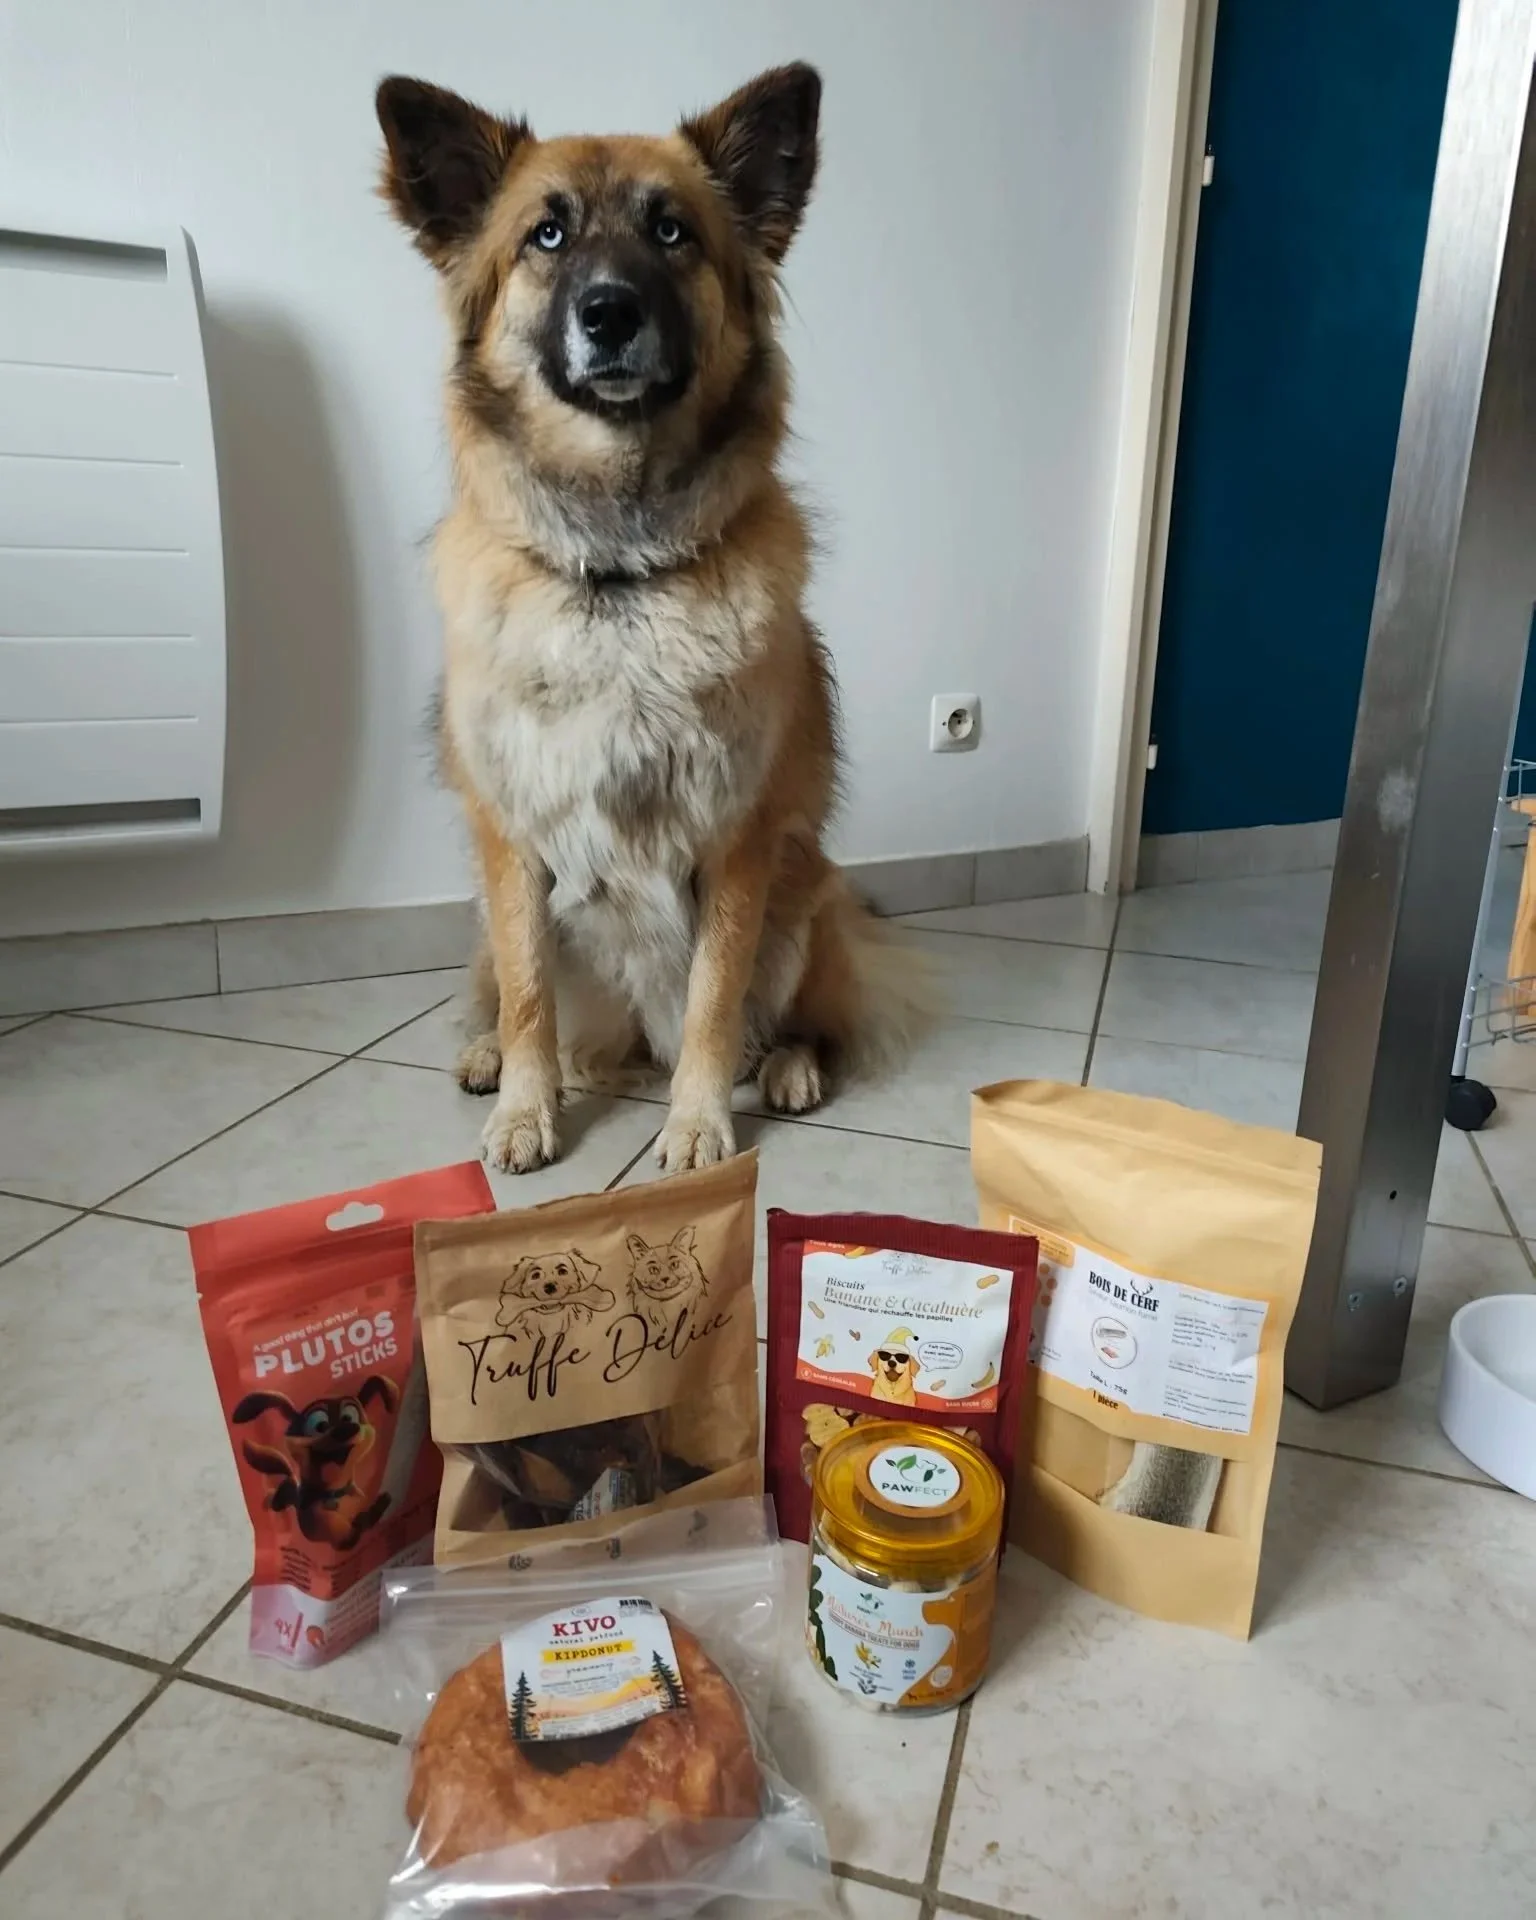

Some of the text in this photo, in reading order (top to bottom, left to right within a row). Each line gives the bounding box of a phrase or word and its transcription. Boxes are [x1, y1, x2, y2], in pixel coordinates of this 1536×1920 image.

[826, 1277, 866, 1291] Biscuits
[1089, 1270, 1111, 1294] BOIS
[1113, 1284, 1128, 1302] DE
[1131, 1293, 1160, 1312] CERF
[824, 1286, 984, 1319] Banane & Cacahuète
[868, 1307, 879, 1315] qui
[915, 1312, 925, 1320] les
[926, 1314, 953, 1323] papilles
[255, 1310, 394, 1378] PLUTOS
[330, 1338, 397, 1379] STICKS
[458, 1334, 591, 1405] Truffe
[881, 1482, 951, 1497] PAWFECT
[553, 1615, 616, 1637] KIVO
[555, 1643, 623, 1661] KIPDONUT
